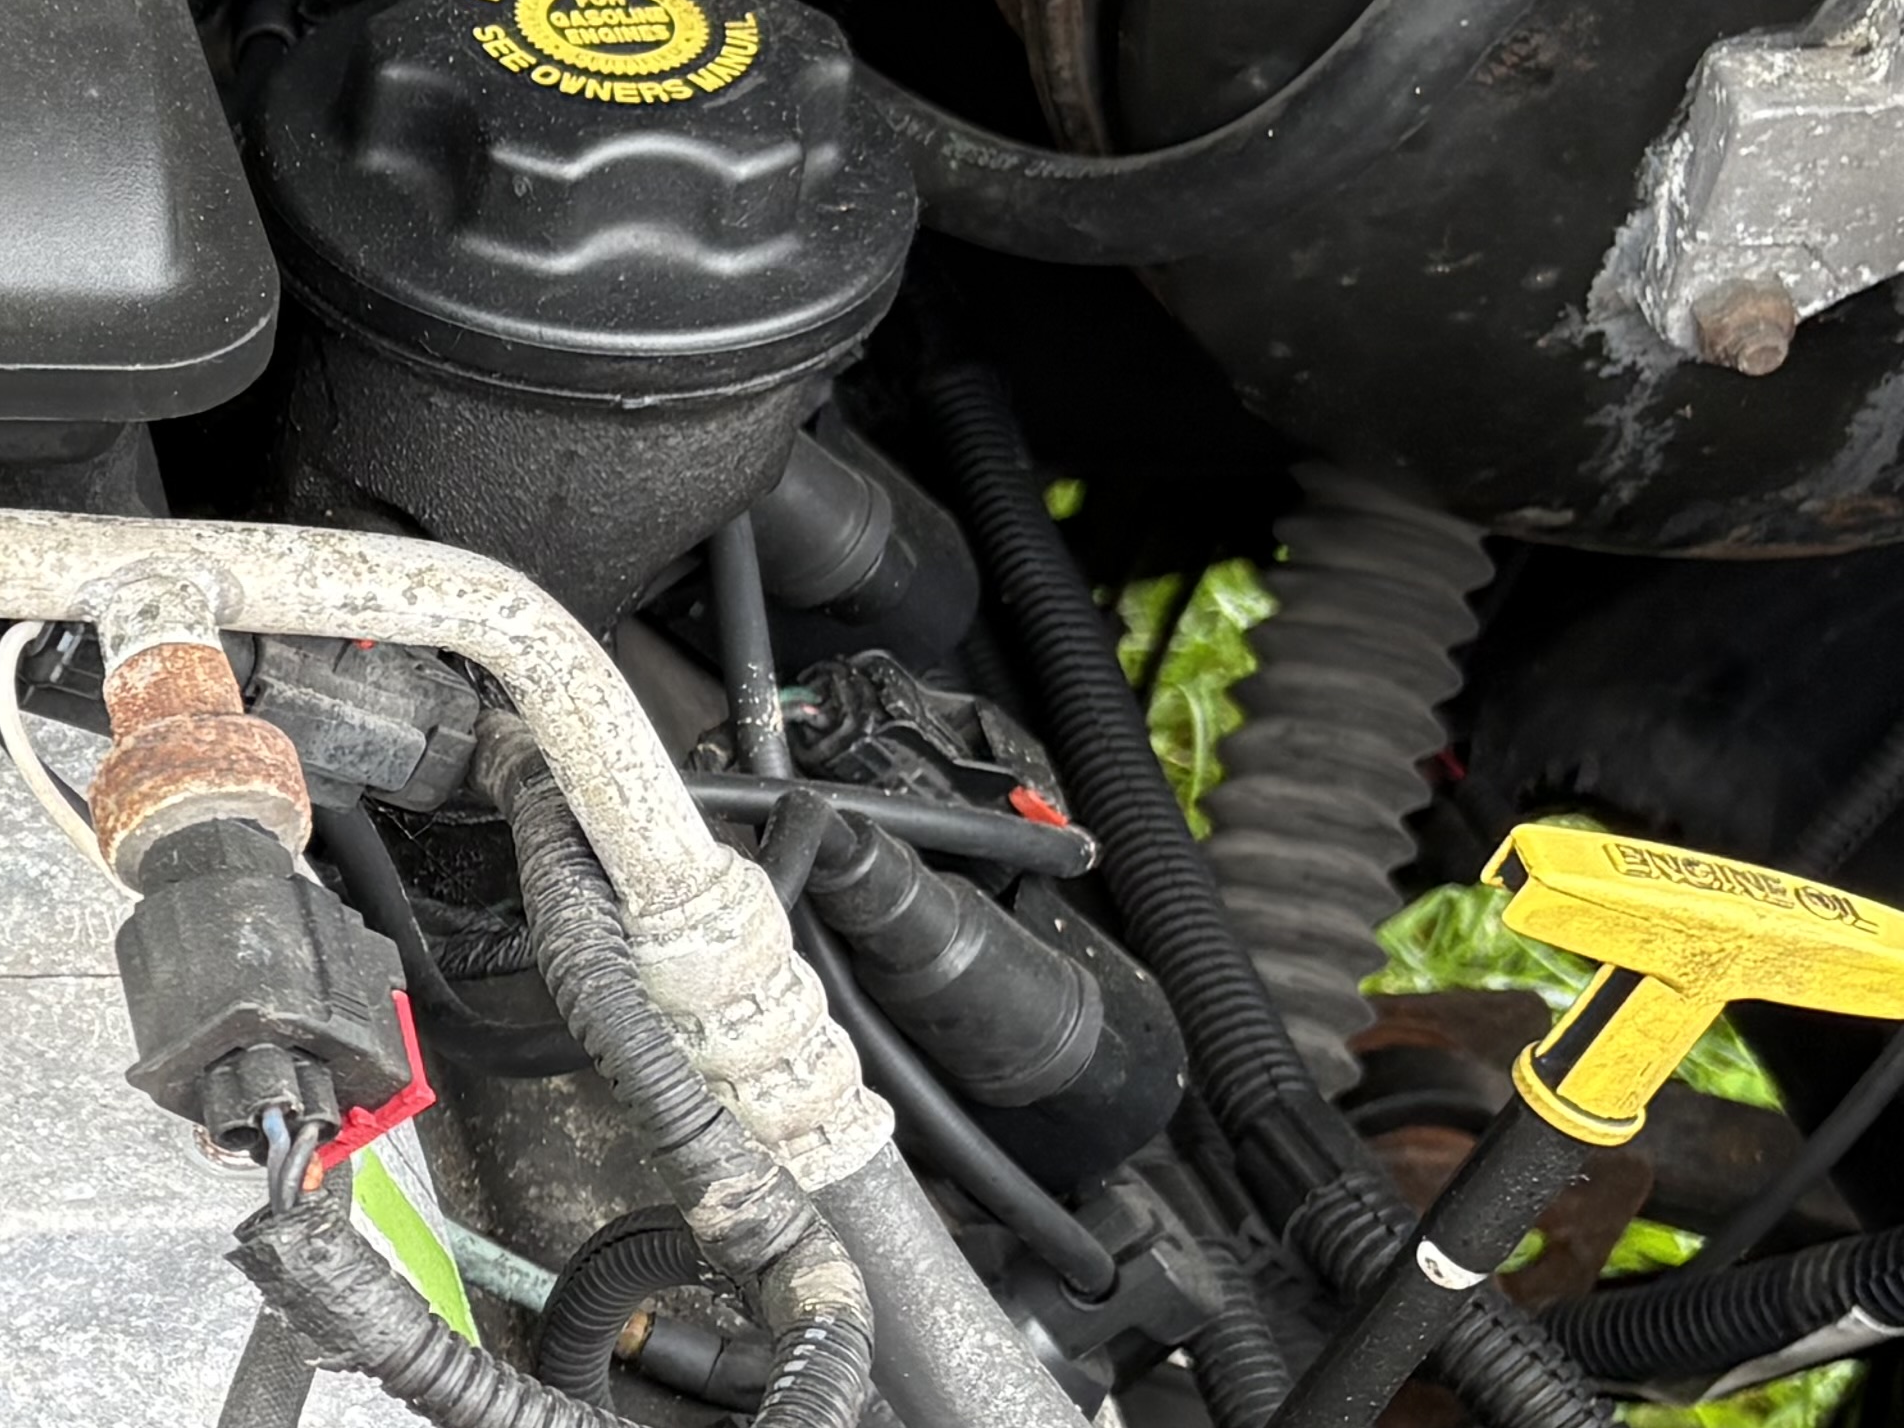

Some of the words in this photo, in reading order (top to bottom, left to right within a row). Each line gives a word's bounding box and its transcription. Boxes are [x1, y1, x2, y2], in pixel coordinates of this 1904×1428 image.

[549, 5, 671, 28] GASOLINE
[564, 23, 671, 45] ENGINES
[472, 23, 537, 73] SEE
[530, 64, 693, 104] OWNERS
[687, 10, 761, 93] MANUAL
[1602, 842, 1795, 910] ENGINE
[1794, 883, 1880, 935] OIL
